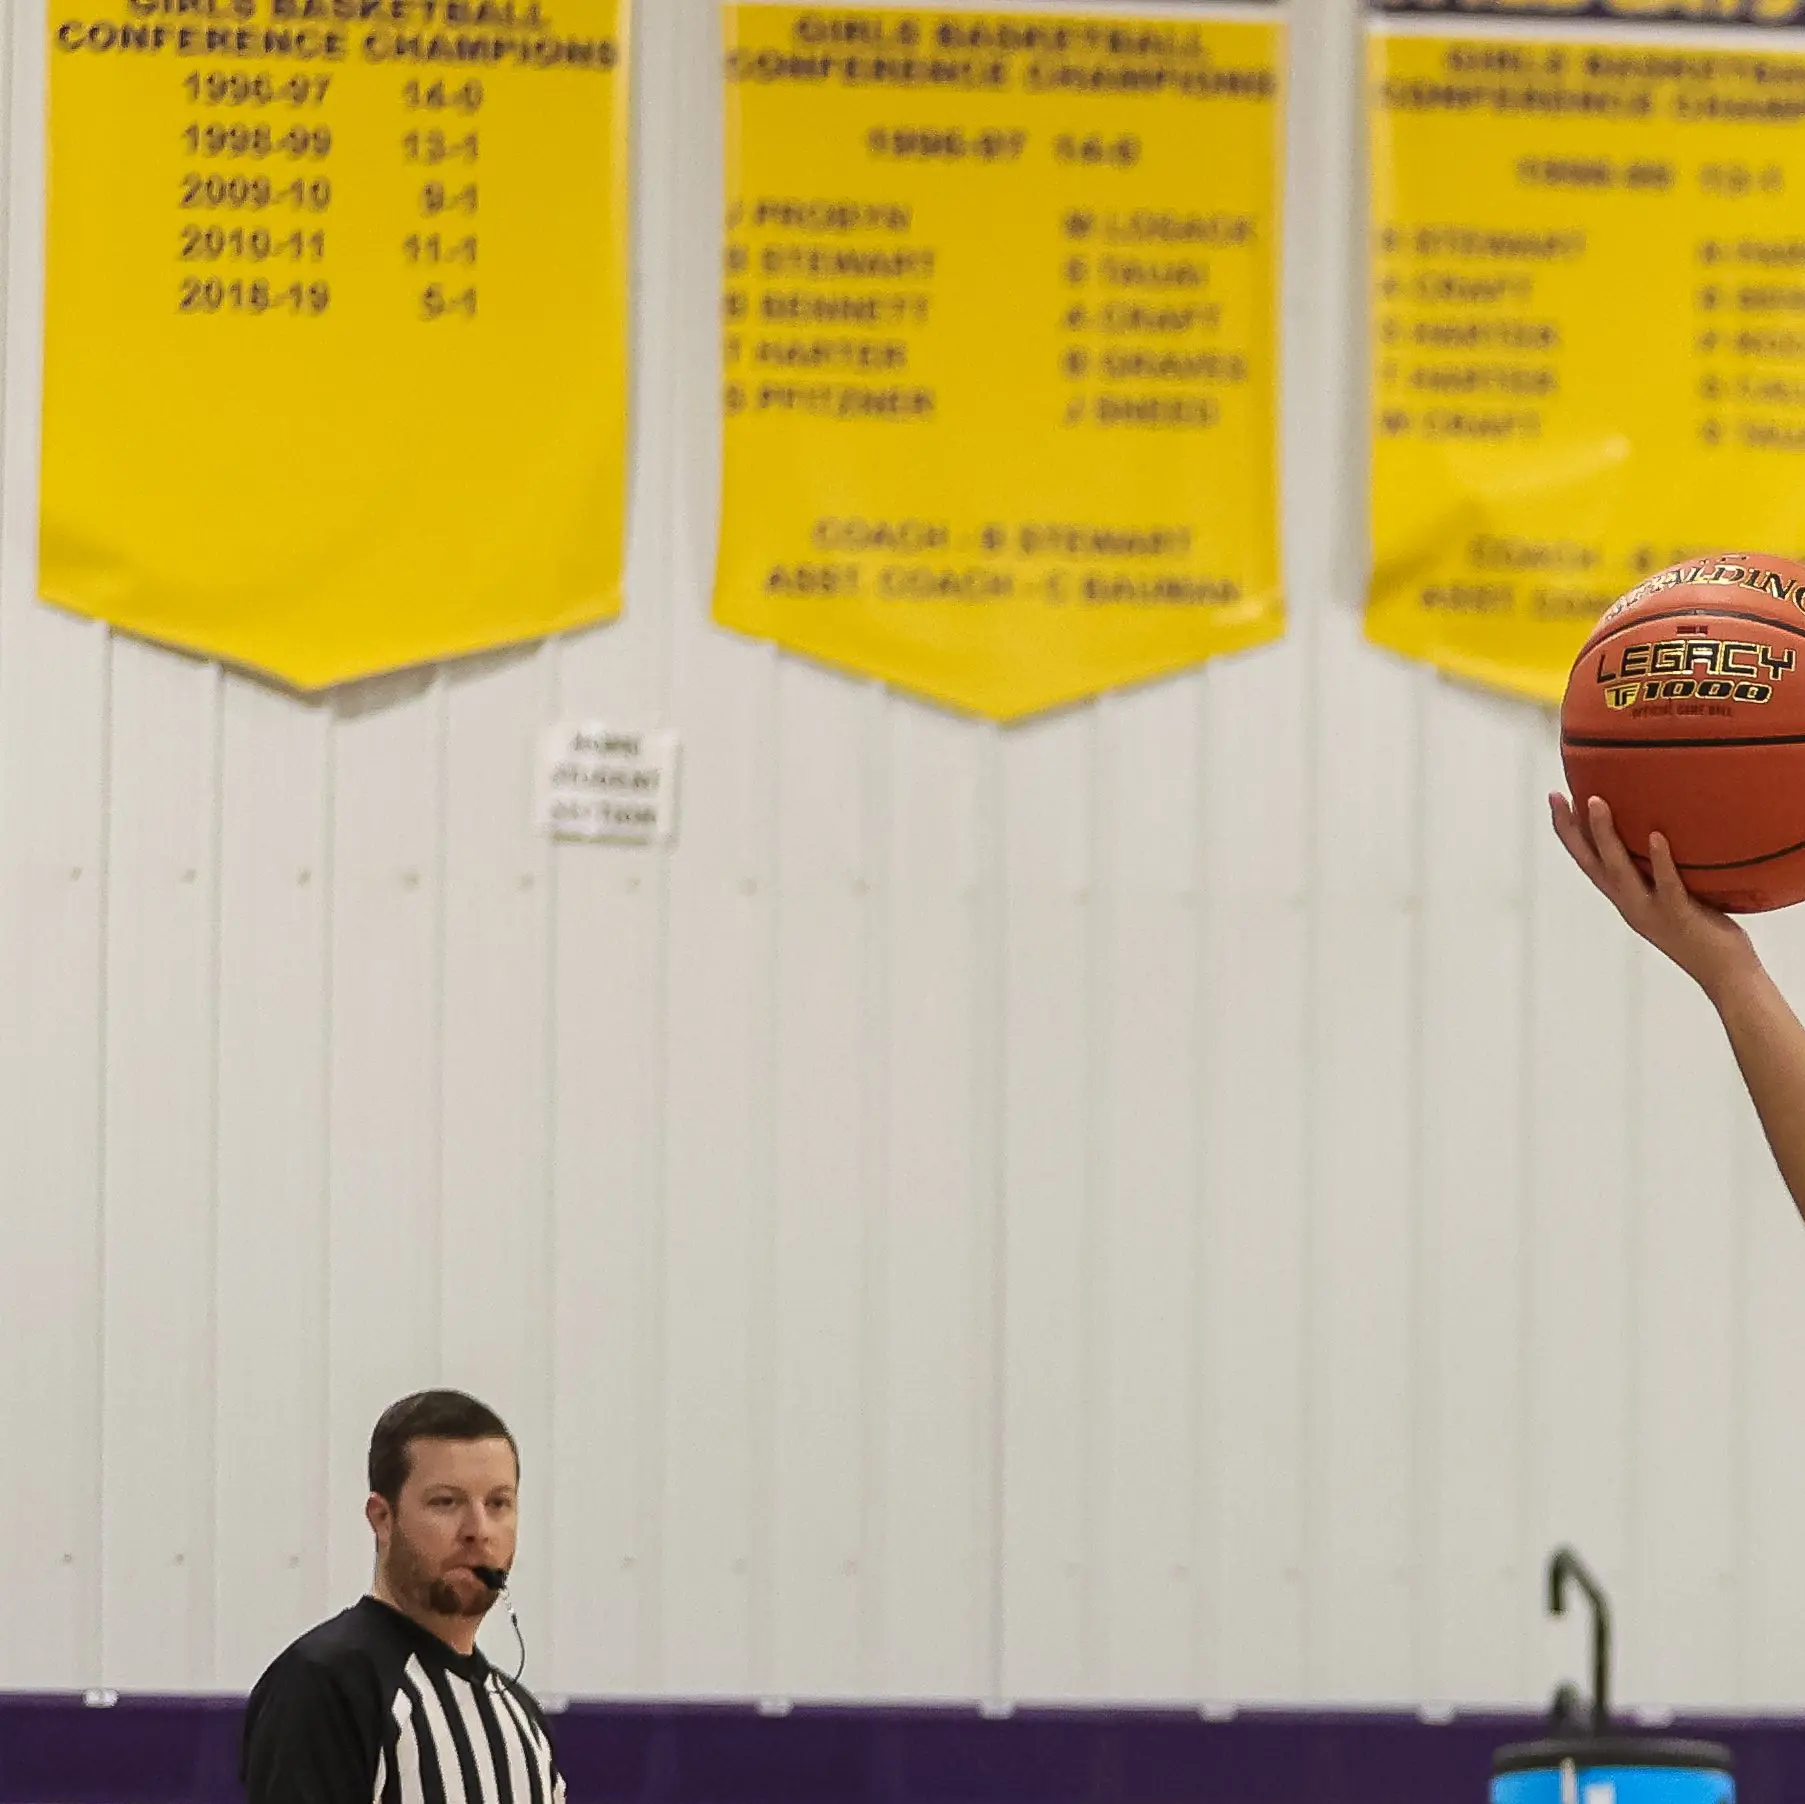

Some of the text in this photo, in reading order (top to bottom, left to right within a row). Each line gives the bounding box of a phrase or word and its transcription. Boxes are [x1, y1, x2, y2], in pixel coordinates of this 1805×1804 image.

[57, 22, 620, 71] CONFERENCE CHAMPIONS
[182, 70, 334, 107] 1996-97
[182, 121, 334, 158] 1998-99
[177, 172, 332, 212] 2009-10
[177, 224, 327, 264] 2010-11
[177, 277, 332, 316] 2018-19
[1597, 639, 1797, 684] LEGACY
[1642, 679, 1773, 704] 1000
